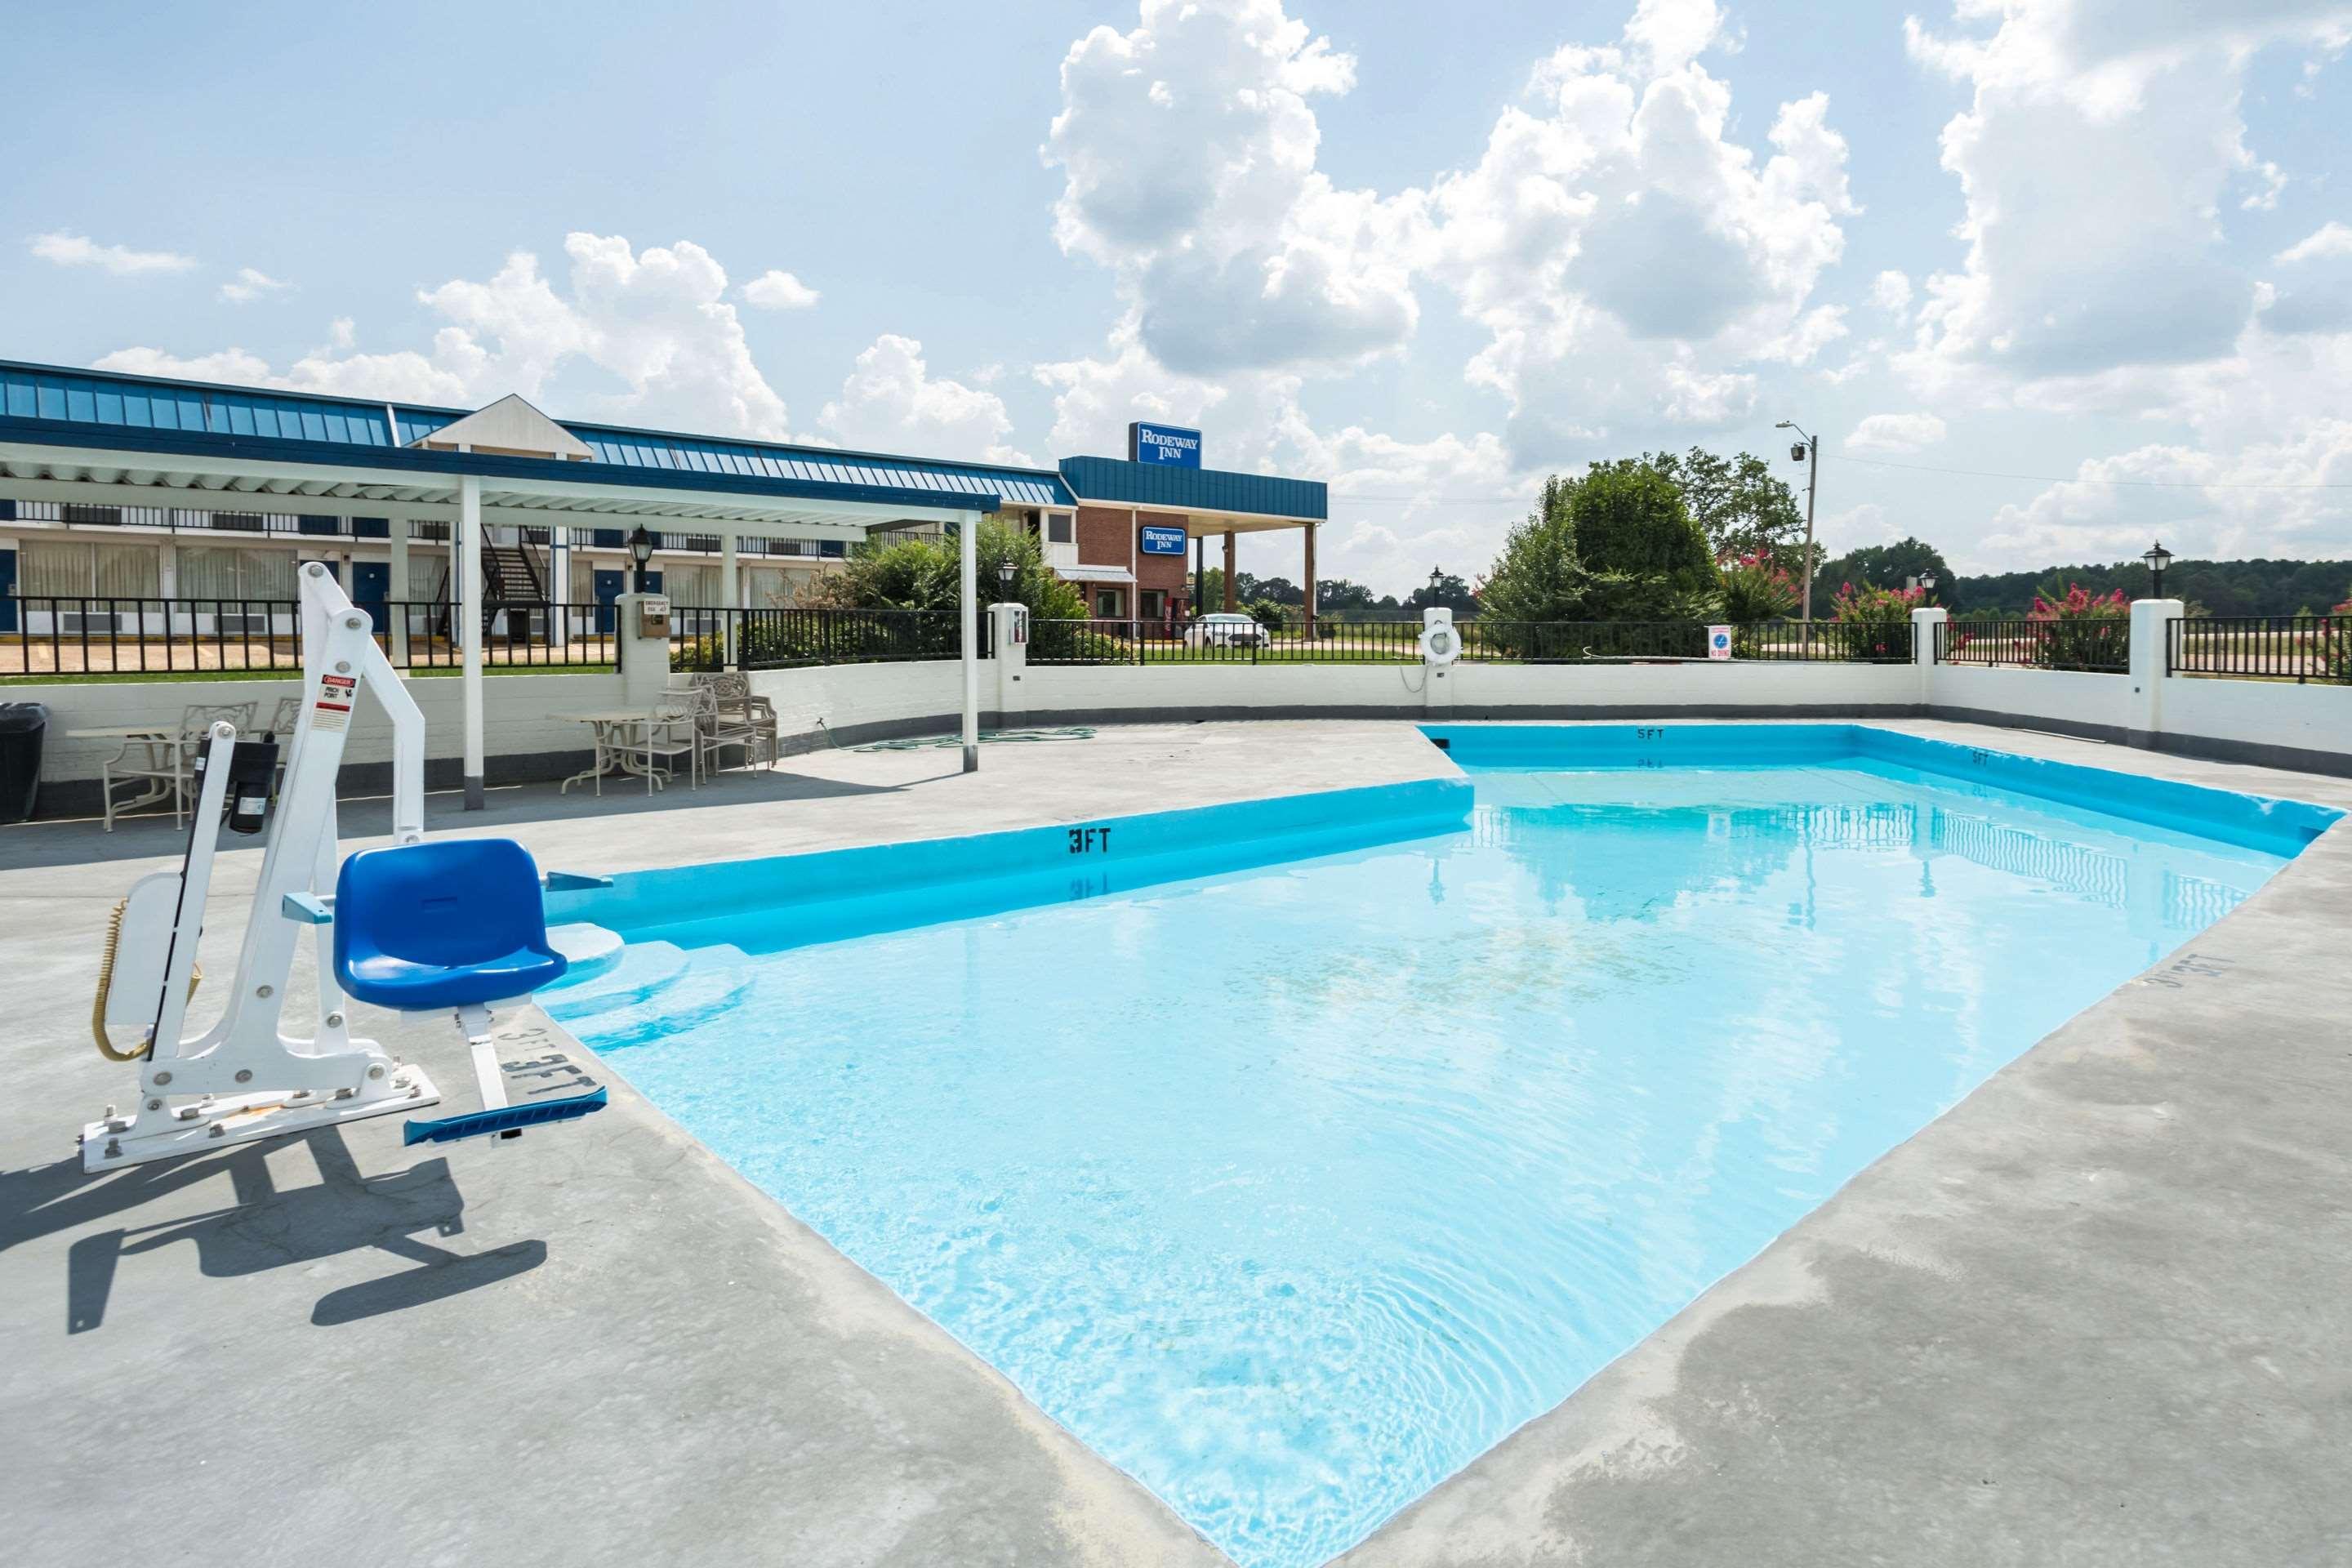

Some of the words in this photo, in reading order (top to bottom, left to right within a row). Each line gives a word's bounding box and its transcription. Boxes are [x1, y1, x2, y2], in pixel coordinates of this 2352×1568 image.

[1141, 429, 1198, 450] RODEWAY
[1158, 446, 1182, 460] INN
[1145, 530, 1183, 541] RODEWAY
[1156, 541, 1172, 550] INN
[326, 677, 352, 685] DANGER
[1637, 728, 1664, 739] 5FT
[1068, 827, 1111, 853] 3FT
[498, 1054, 598, 1095] 3FT
